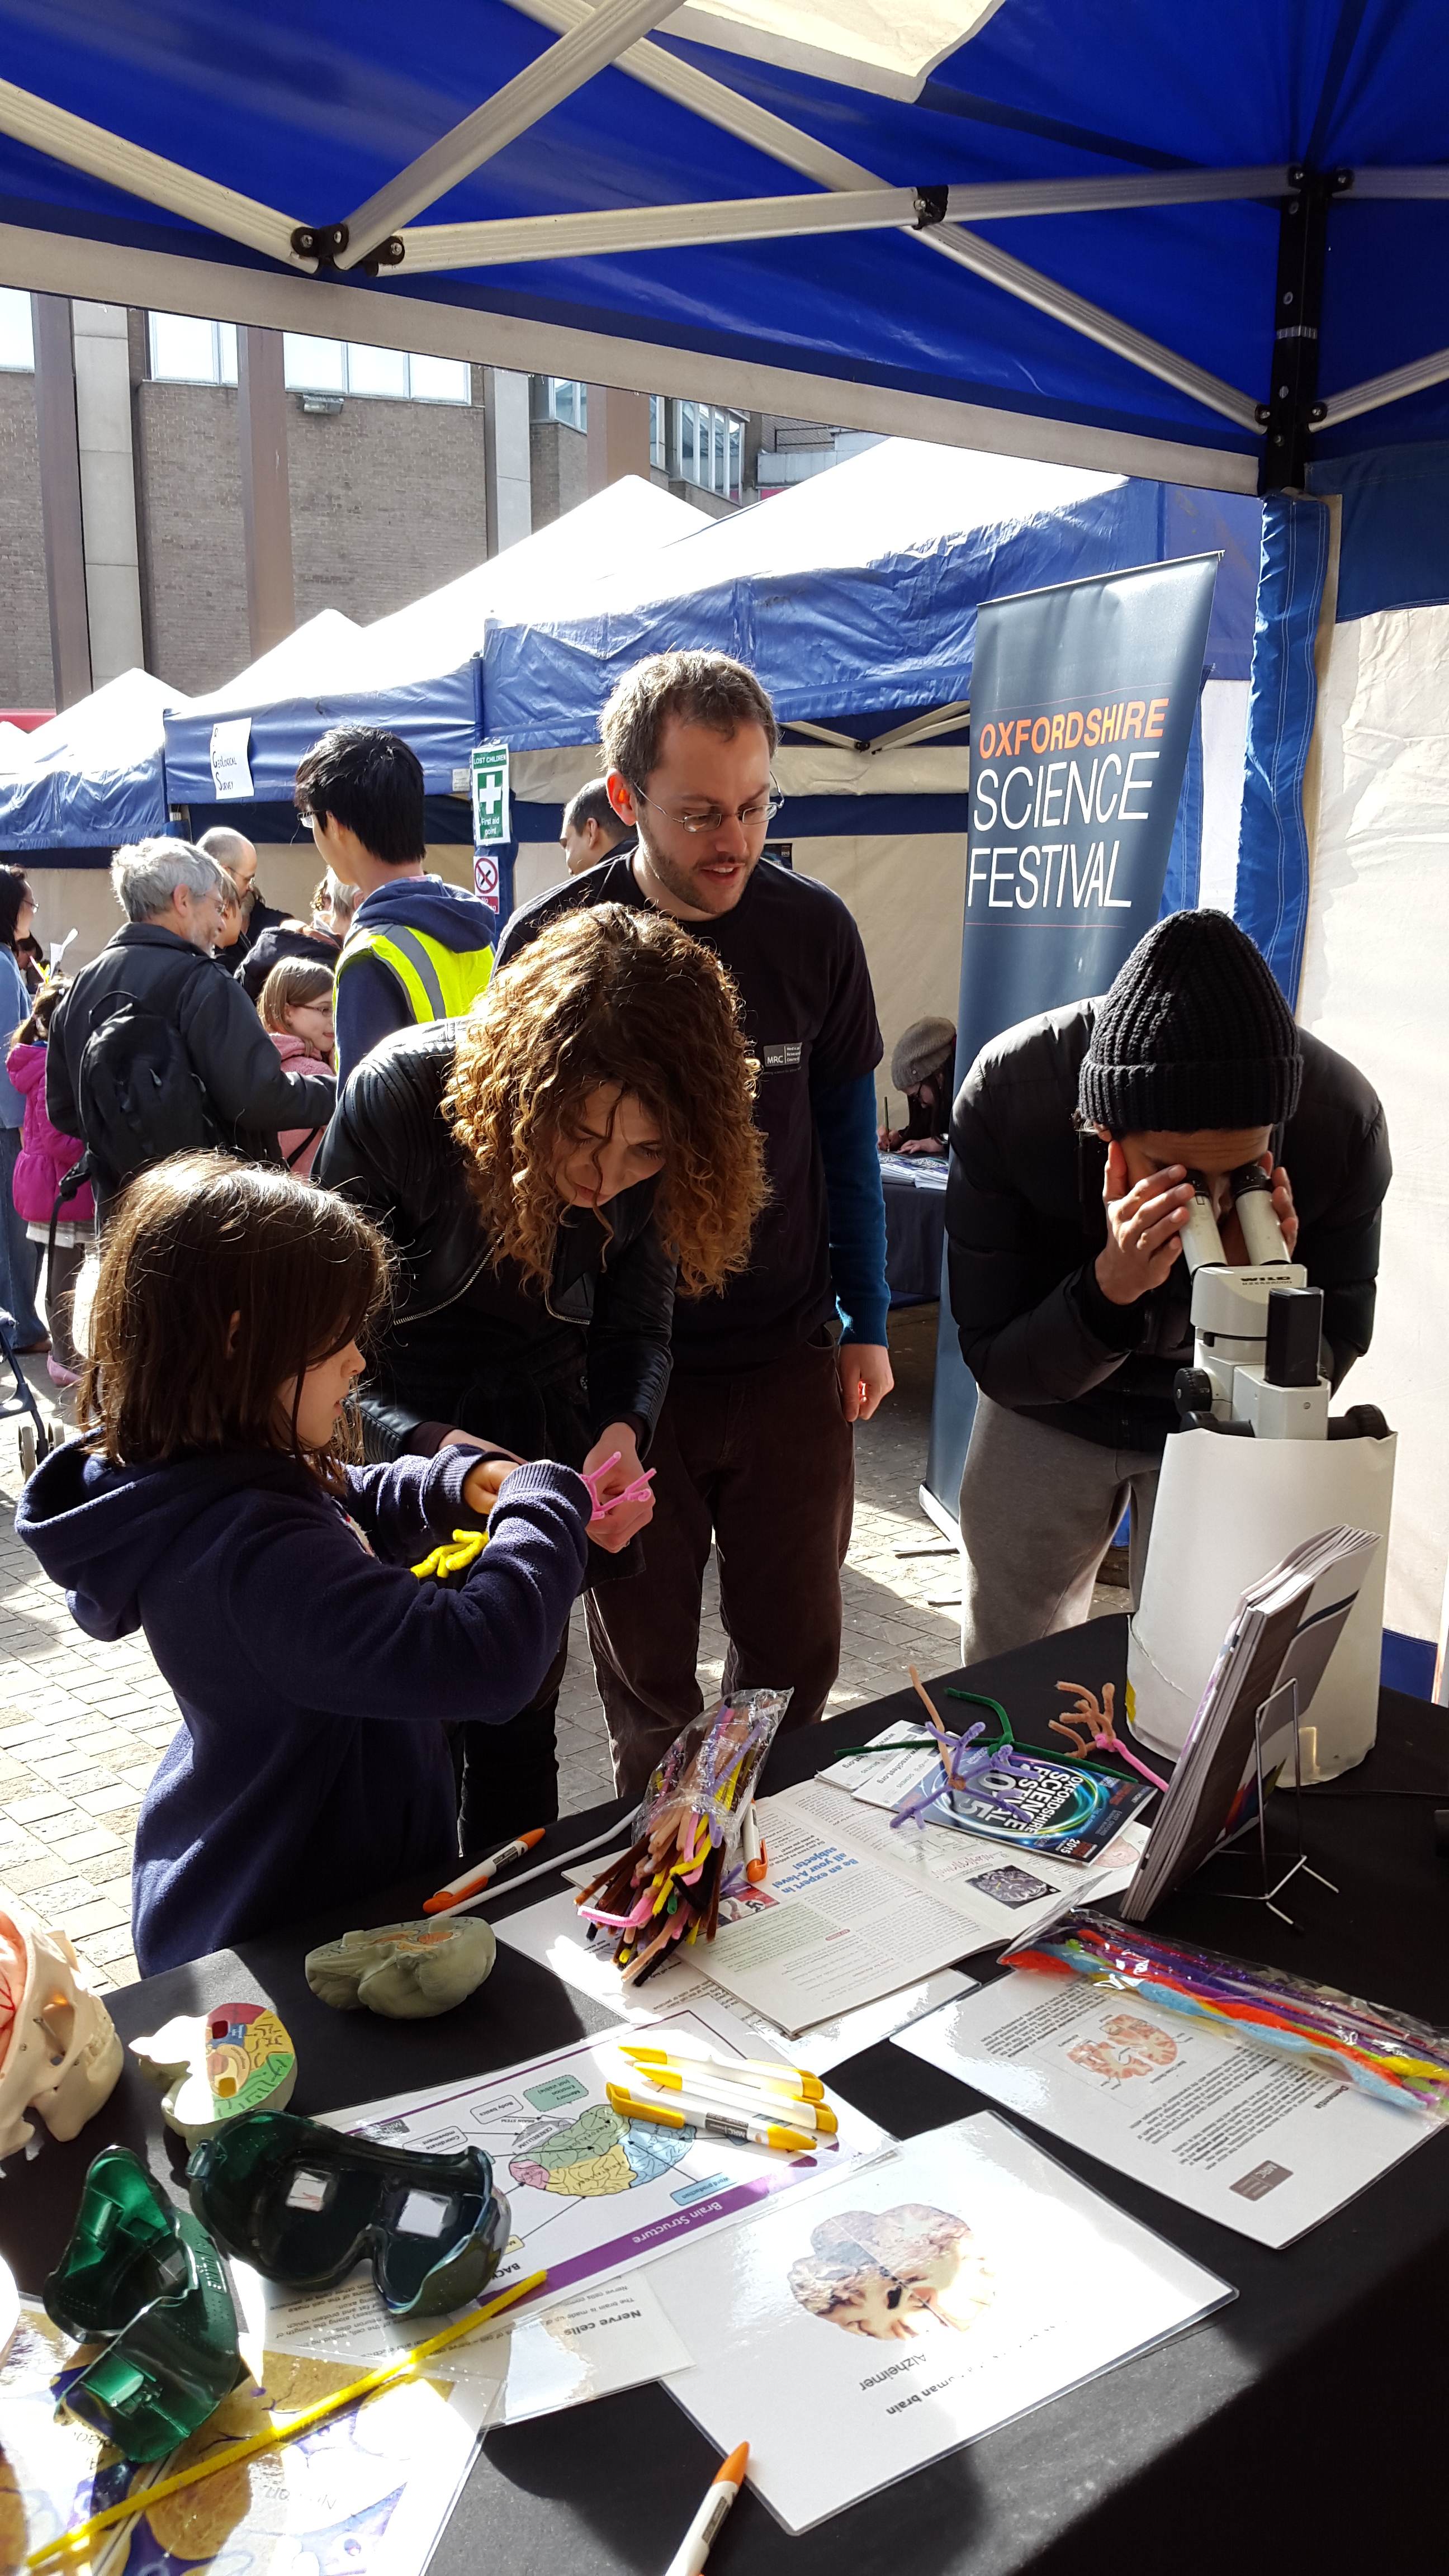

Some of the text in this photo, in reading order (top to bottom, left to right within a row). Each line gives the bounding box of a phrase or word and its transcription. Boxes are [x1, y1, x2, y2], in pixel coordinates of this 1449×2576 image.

[979, 698, 1169, 759] OXFORDSHIRE
[486, 754, 506, 763] CHILDREN
[974, 751, 1160, 831] SCIENCE
[968, 840, 1131, 909] FESTIVAL
[767, 1055, 783, 1064] MRC
[1024, 1777, 1083, 1835] OXFORDSHIRE
[1059, 1838, 1080, 1855] 2015
[771, 1851, 847, 1891] all your A-level
[780, 1857, 858, 1897] Be an expert in
[479, 2100, 513, 2117] Body basics
[422, 2130, 455, 2145] movement
[425, 2135, 460, 2150] Coordinate
[517, 2126, 552, 2149] CEREBELLUM
[1254, 2160, 1277, 2181] MRC
[632, 2201, 723, 2244] Brain Structure
[604, 2285, 627, 2295] Nerve
[598, 2300, 618, 2311] brain
[619, 2296, 634, 2305] The
[567, 2309, 588, 2319] made
[599, 2308, 641, 2328] Nerve
[563, 2321, 596, 2337] cells
[859, 2352, 926, 2392] Alzheimer
[886, 2394, 922, 2416] brain
